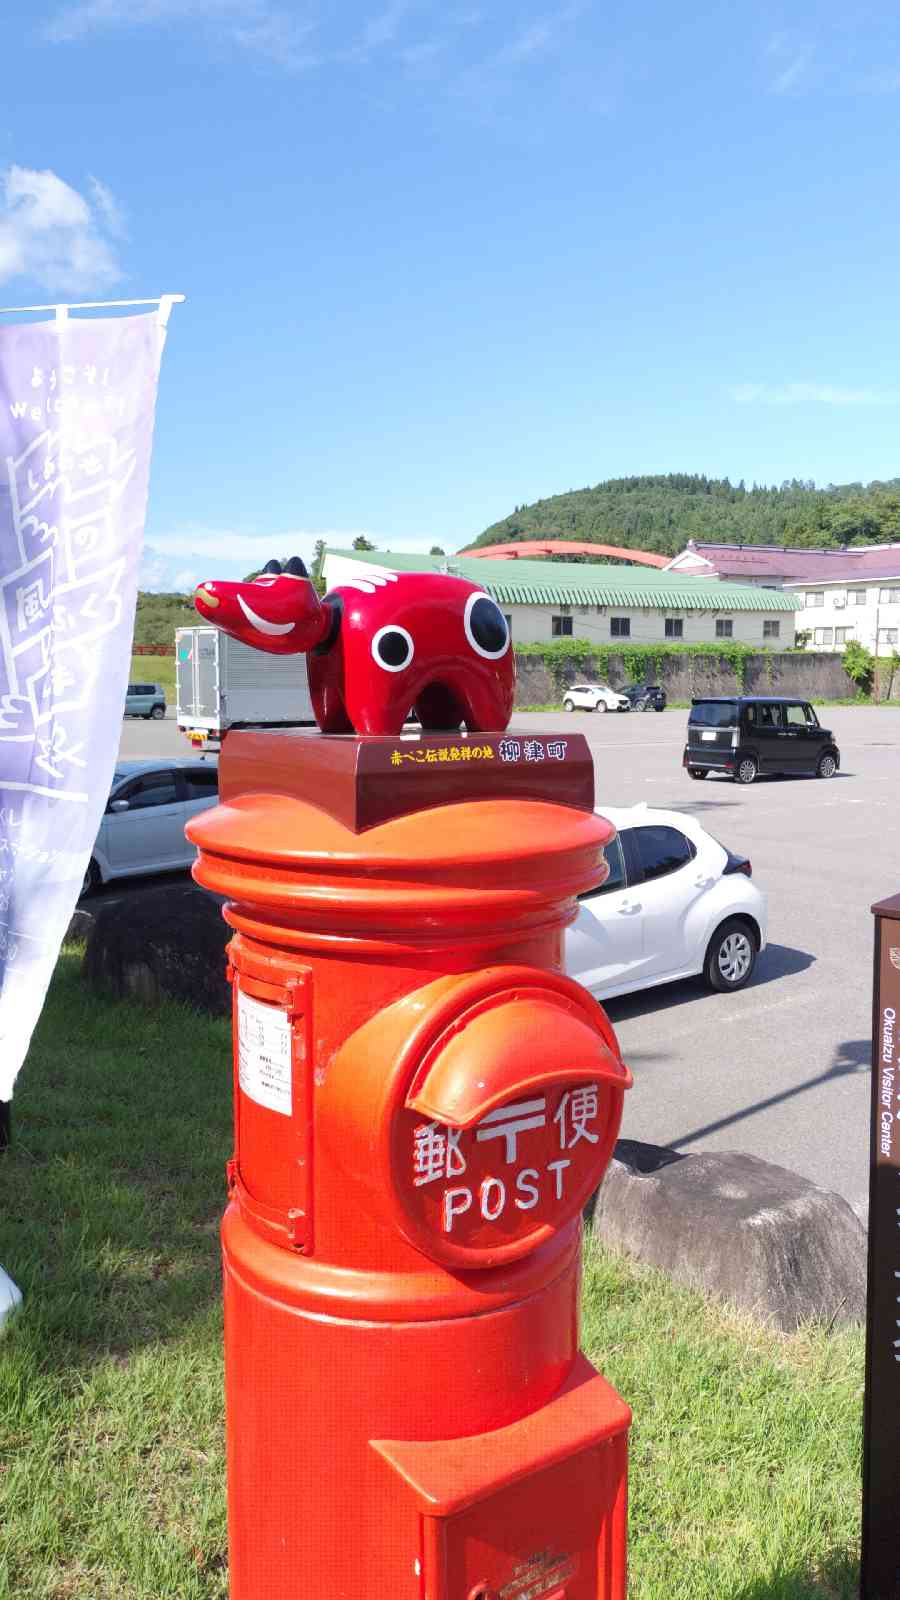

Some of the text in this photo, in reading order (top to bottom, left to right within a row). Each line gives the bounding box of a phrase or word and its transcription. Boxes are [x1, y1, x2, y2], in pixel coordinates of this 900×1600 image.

[499, 739, 568, 762] 柳津町
[880, 1007, 896, 1158] Okuaizu Visitor Center
[443, 1159, 572, 1233] POST
